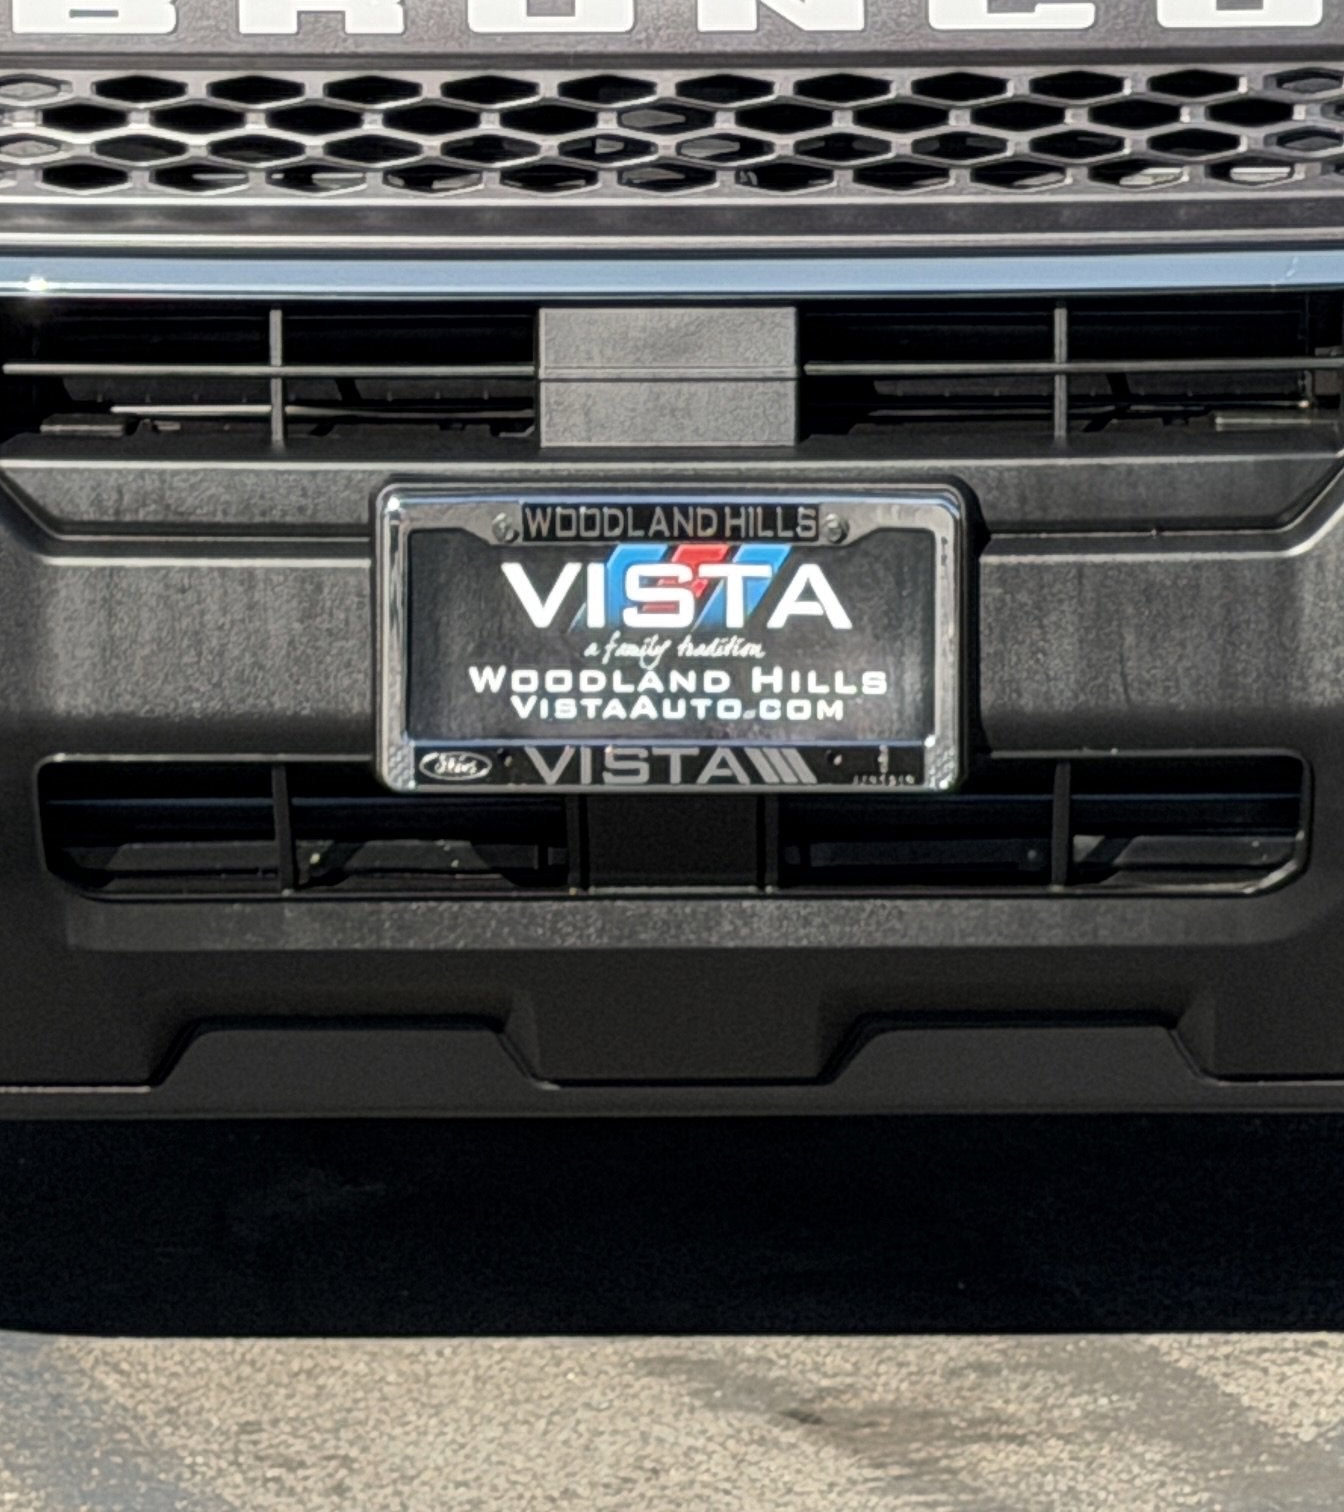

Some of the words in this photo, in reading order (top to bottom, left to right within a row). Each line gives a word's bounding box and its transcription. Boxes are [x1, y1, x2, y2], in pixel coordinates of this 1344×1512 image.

[525, 506, 718, 537] WOODLAND
[724, 505, 818, 536] HILLS
[501, 562, 853, 630] VISTA
[584, 642, 600, 657] a
[601, 630, 672, 670] family
[677, 634, 766, 659] tradition
[468, 665, 731, 695] WOODLAND
[751, 665, 888, 695] HILLS
[524, 746, 755, 785] VISTA
